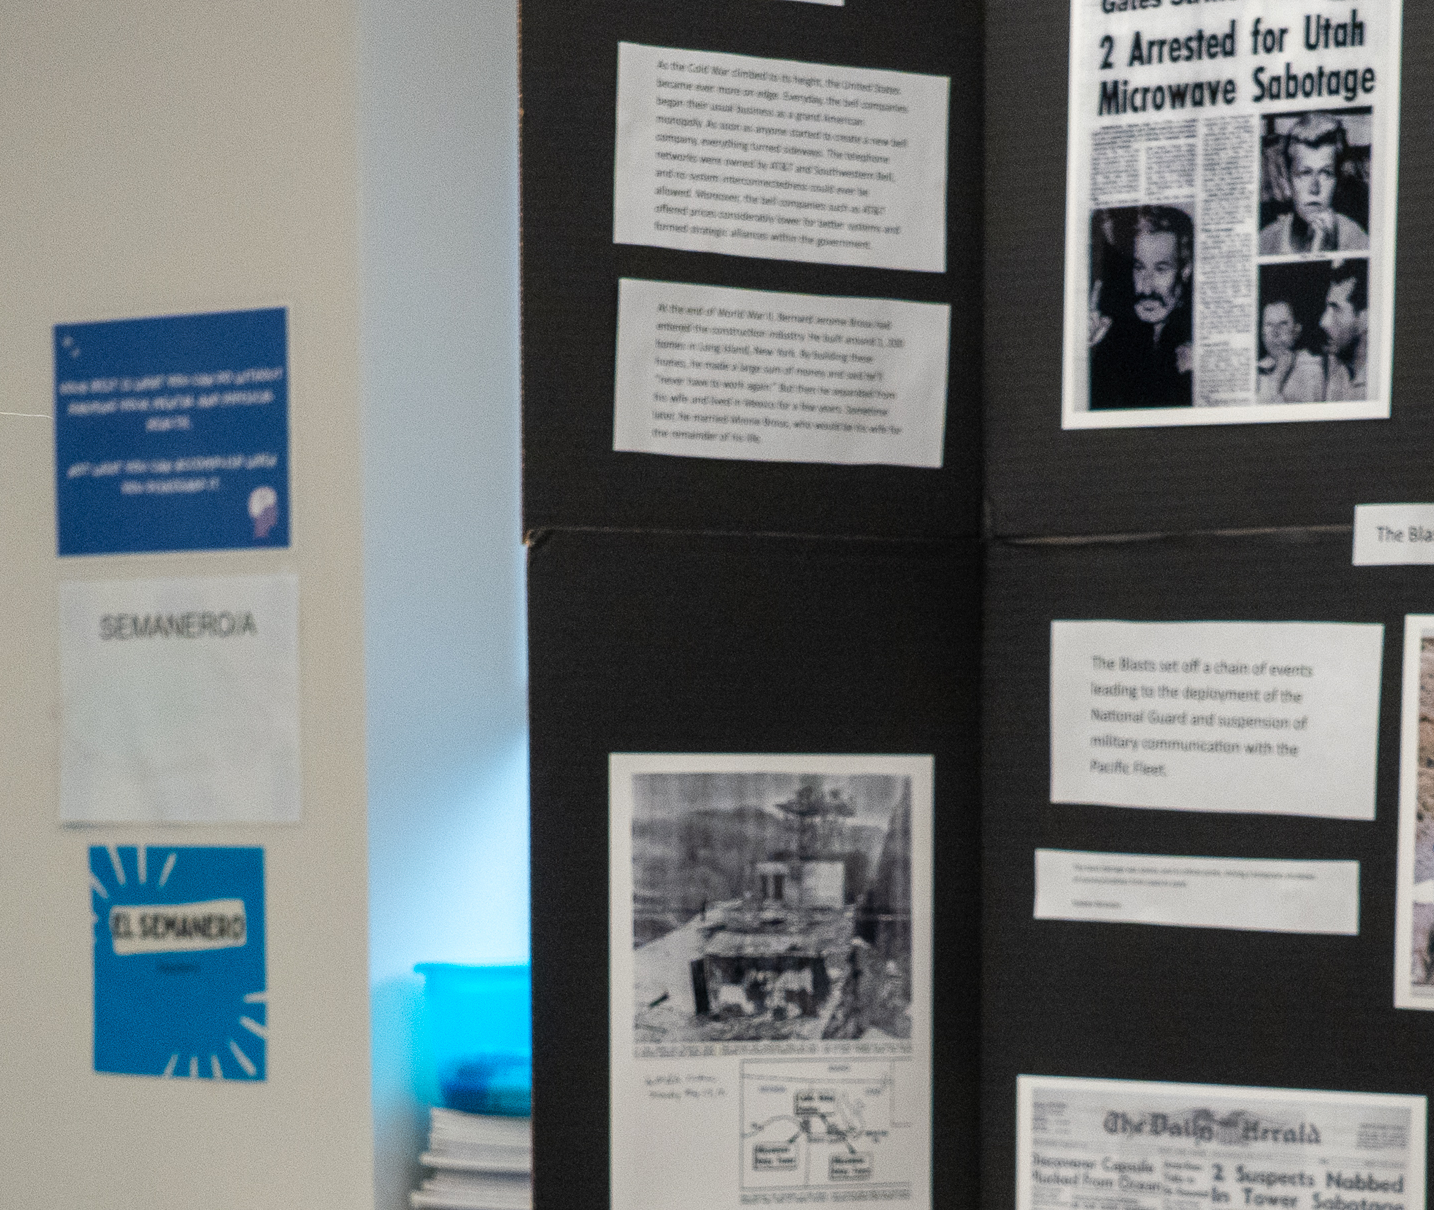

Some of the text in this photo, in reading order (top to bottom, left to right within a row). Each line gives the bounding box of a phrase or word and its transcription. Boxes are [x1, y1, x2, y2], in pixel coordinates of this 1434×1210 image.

[1099, 10, 1366, 71] 2 Arrested for Utah
[1098, 66, 1376, 115] Microwave Sabotage
[1377, 525, 1404, 543] The
[1090, 654, 1117, 671] The
[1118, 656, 1157, 673] Blasts
[1159, 660, 1179, 673] set
[1181, 657, 1201, 674] off
[1213, 660, 1250, 676] chain
[1252, 662, 1267, 676] of
[1269, 665, 1313, 677] events
[1090, 682, 1303, 704] leading to the deployment of the
[1090, 707, 1308, 731] National Guard and suspension of
[1090, 733, 1299, 758] military communication with the
[1090, 759, 1130, 775] Pacific
[139, 911, 246, 941] SEMANERO
[1103, 1110, 1146, 1137] The
[1149, 1110, 1214, 1146] Daily
[1241, 1119, 1321, 1144] Herald
[1212, 1162, 1225, 1183] 2
[1235, 1164, 1315, 1187] Suspects
[1326, 1172, 1405, 1194] Nabbed
[1208, 1186, 1230, 1204] In
[1241, 1187, 1298, 1209] Tower
